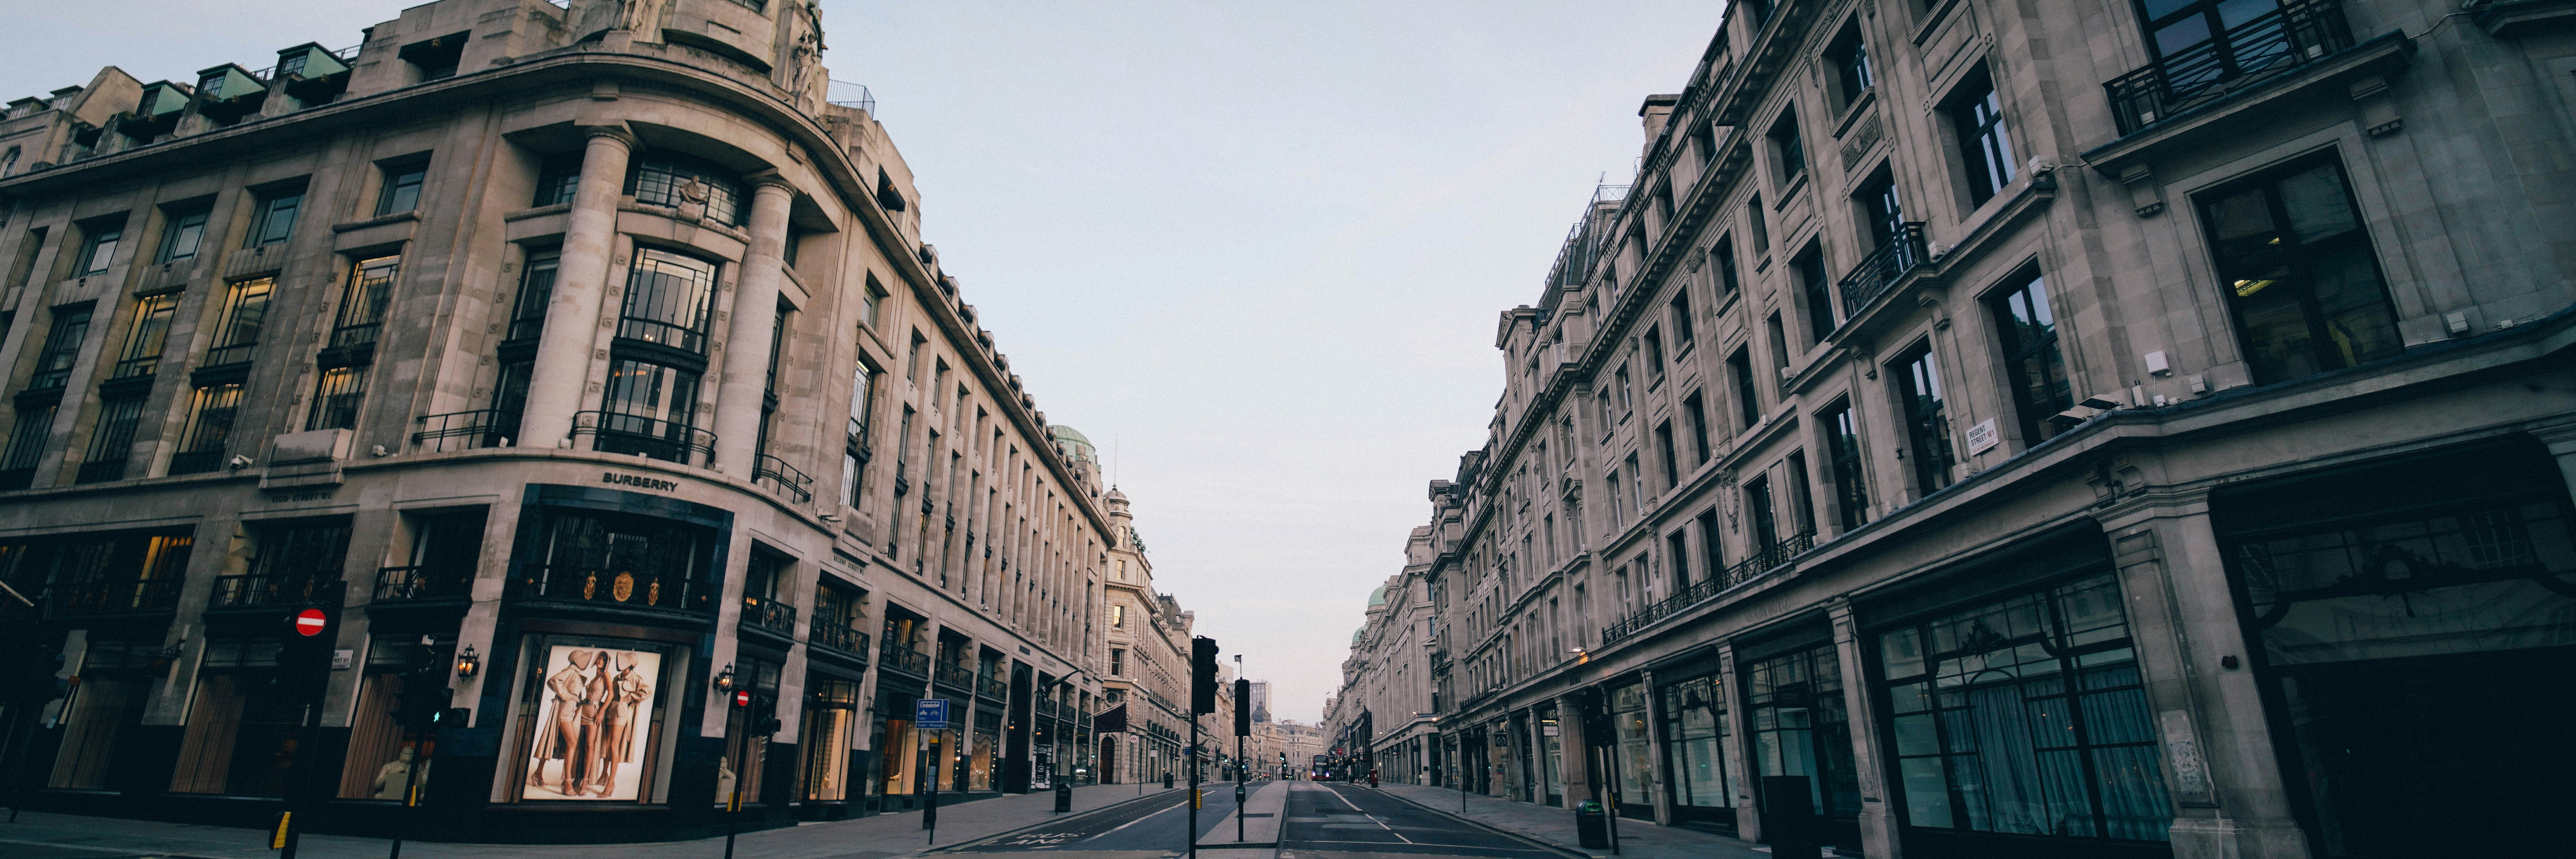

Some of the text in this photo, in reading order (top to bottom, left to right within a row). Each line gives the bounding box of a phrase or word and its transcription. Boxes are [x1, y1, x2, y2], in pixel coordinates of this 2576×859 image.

[1969, 425, 1985, 438] REGENT
[1971, 429, 1994, 446] STREET W1
[603, 473, 678, 492] BURBERRY
[292, 494, 318, 502] STREET
[834, 555, 846, 566] REGENT
[848, 563, 859, 572] STREET
[1570, 676, 1581, 686] ZARA
